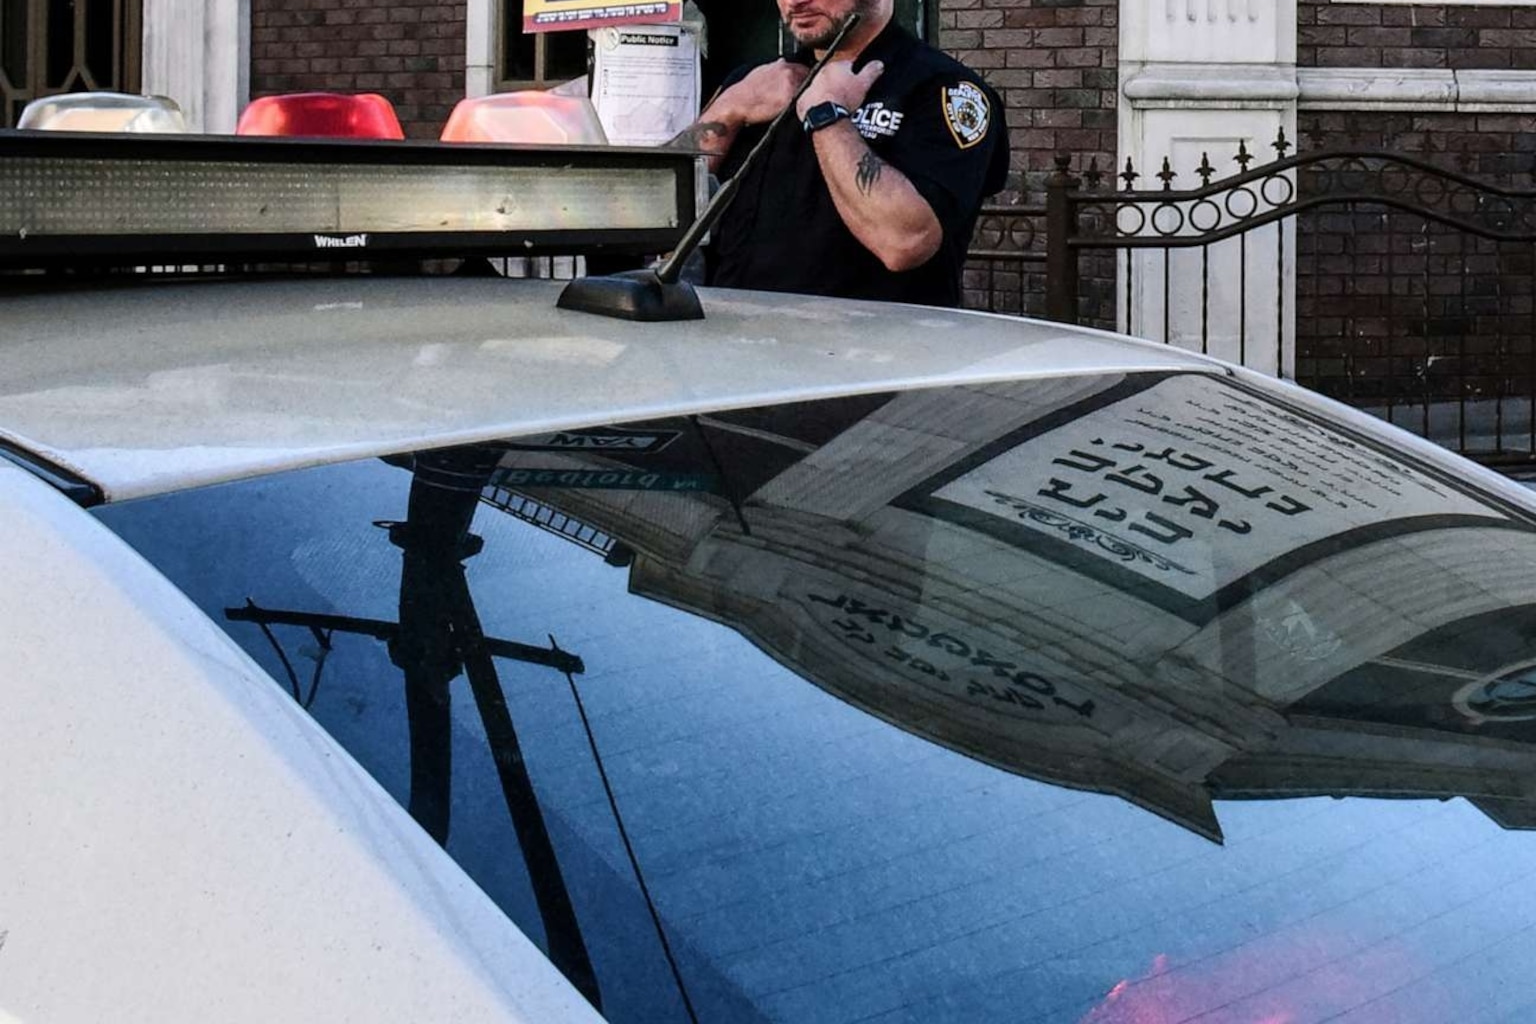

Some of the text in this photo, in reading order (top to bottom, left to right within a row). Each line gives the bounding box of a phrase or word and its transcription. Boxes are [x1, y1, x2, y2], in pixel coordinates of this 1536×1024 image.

[620, 34, 675, 46] Public Notice
[851, 107, 905, 131] OLICE
[314, 234, 367, 248] WHELEN
